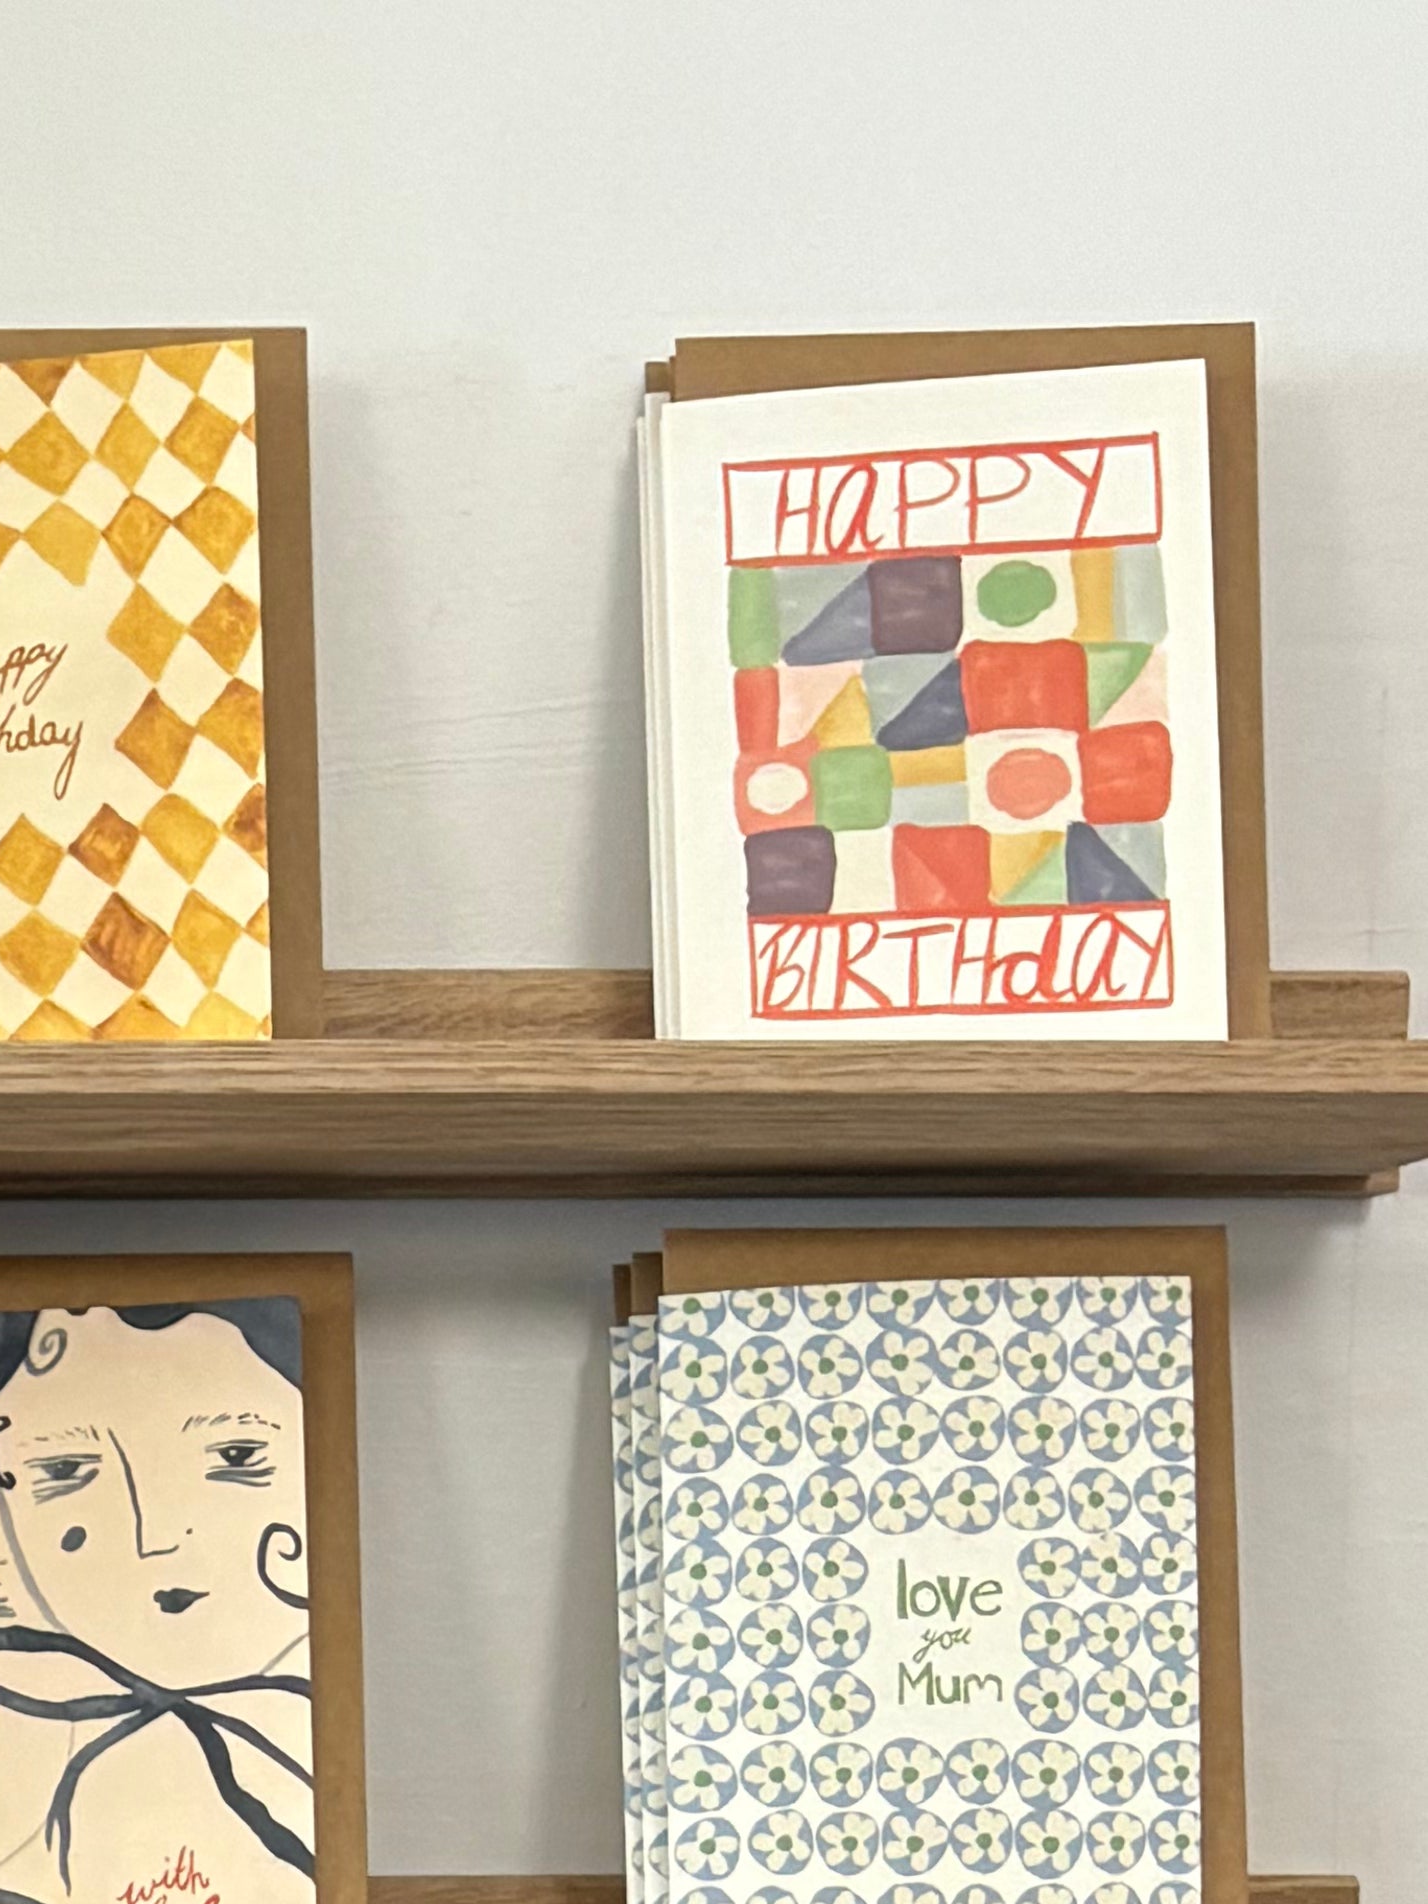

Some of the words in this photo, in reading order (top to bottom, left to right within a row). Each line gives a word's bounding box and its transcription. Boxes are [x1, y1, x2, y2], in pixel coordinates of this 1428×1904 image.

[897, 1558, 1003, 1622] love
[912, 1627, 971, 1664] you
[898, 1661, 1003, 1705] Mum
